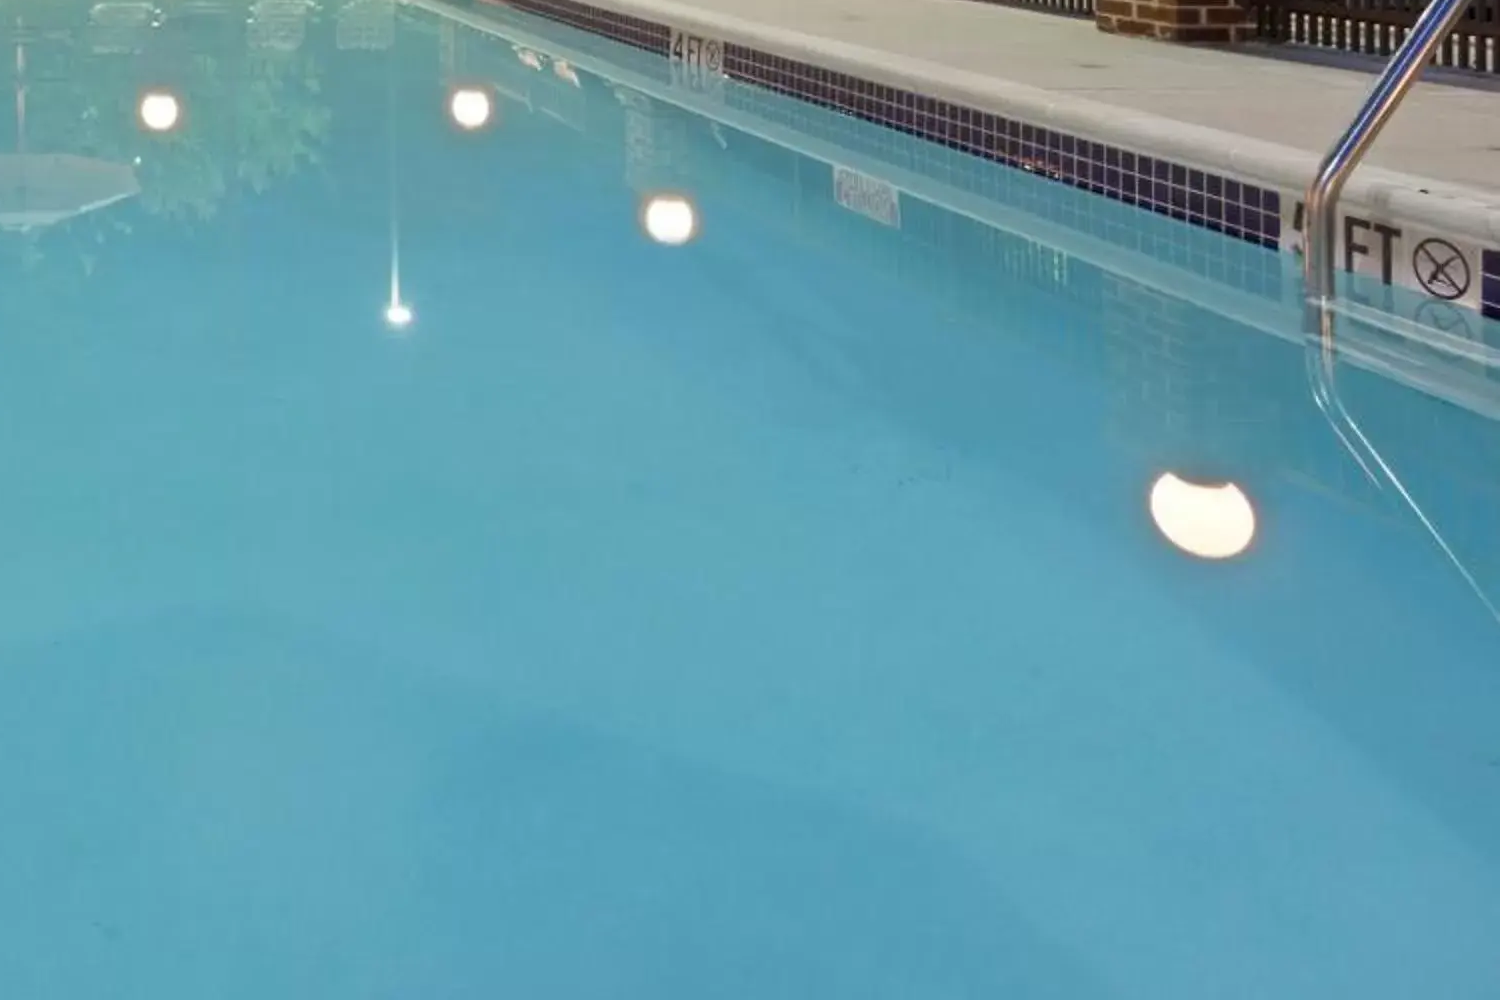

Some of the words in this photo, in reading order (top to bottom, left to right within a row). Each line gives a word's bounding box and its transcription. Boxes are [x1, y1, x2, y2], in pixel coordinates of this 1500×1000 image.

[673, 32, 683, 59] 4
[687, 35, 704, 66] FT
[1344, 215, 1402, 286] FT
